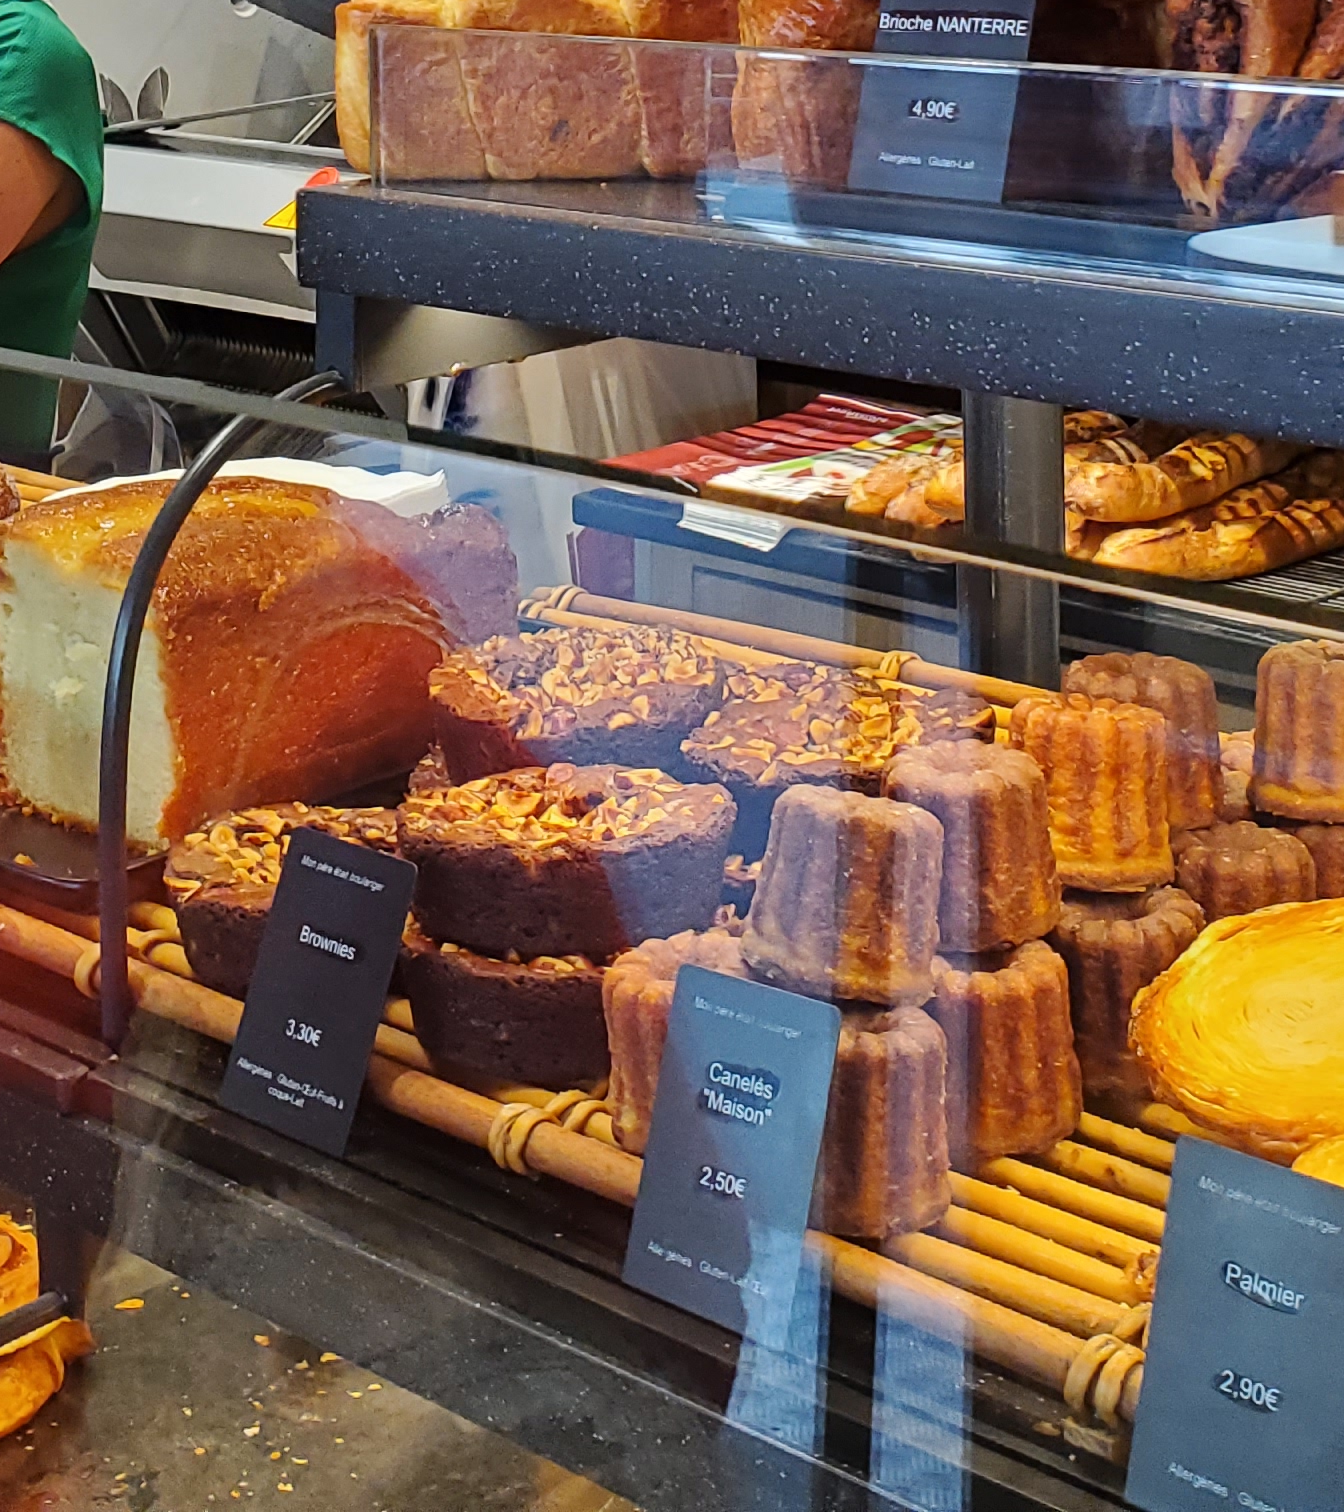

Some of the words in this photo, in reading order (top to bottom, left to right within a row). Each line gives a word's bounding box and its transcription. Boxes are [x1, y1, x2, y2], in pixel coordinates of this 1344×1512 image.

[878, 12, 933, 33] Brioche
[937, 15, 1029, 37] NANTERRE
[912, 99, 957, 121] 4,90€
[299, 925, 357, 961] Brownies
[285, 1018, 323, 1048] 3,30€
[708, 1061, 774, 1101] Canelés
[703, 1088, 773, 1126] "Maison"
[699, 1166, 748, 1200] 2,50€
[1224, 1261, 1305, 1311] Palmier
[1218, 1368, 1284, 1413] 2,90€
